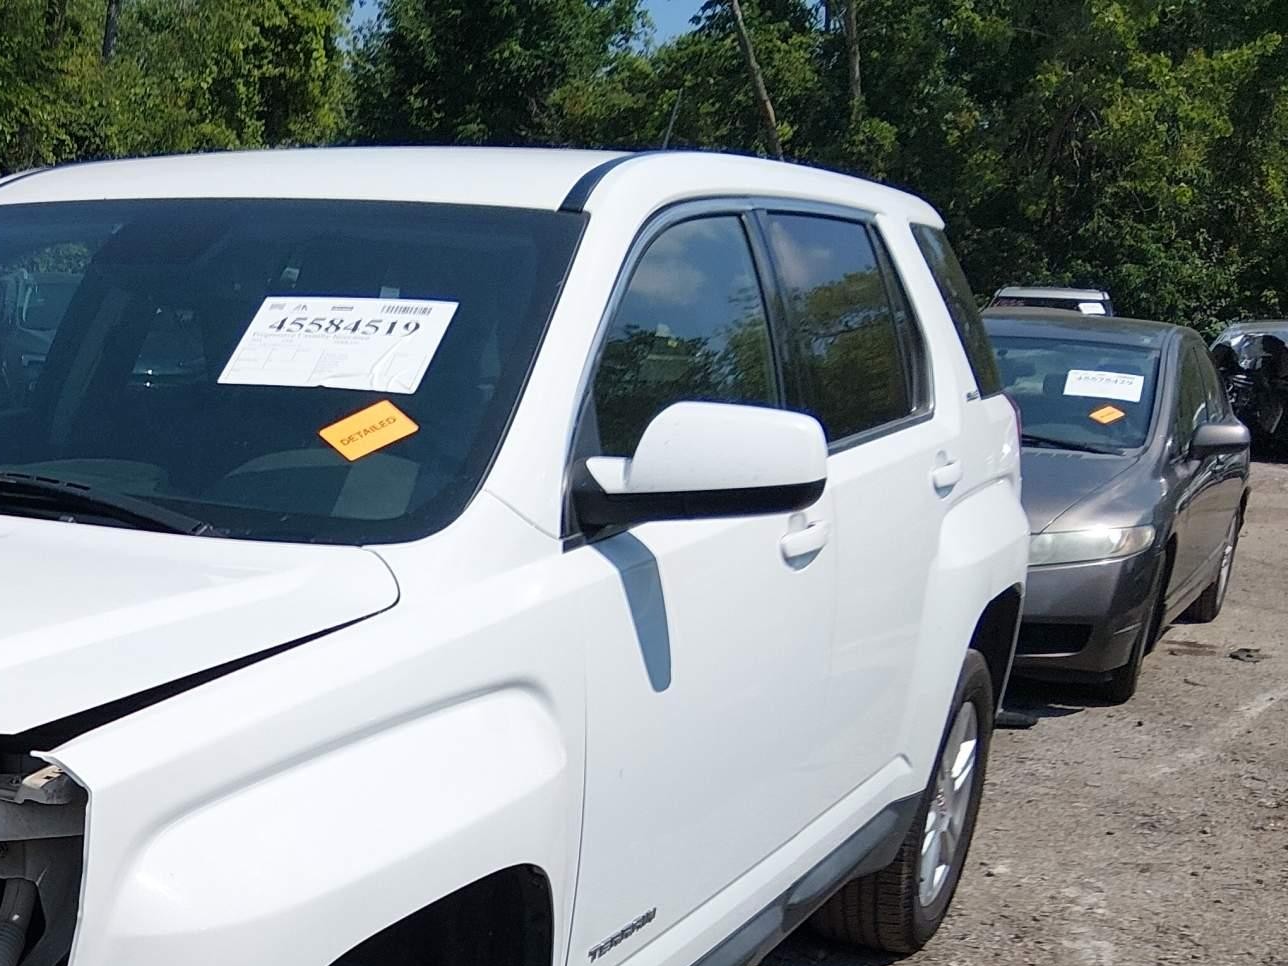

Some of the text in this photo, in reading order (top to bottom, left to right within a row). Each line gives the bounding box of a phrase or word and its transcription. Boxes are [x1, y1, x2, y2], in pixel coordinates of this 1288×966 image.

[268, 316, 421, 338] 45584519
[340, 417, 396, 446] DETAILED
[588, 907, 657, 963] TERRAIN
